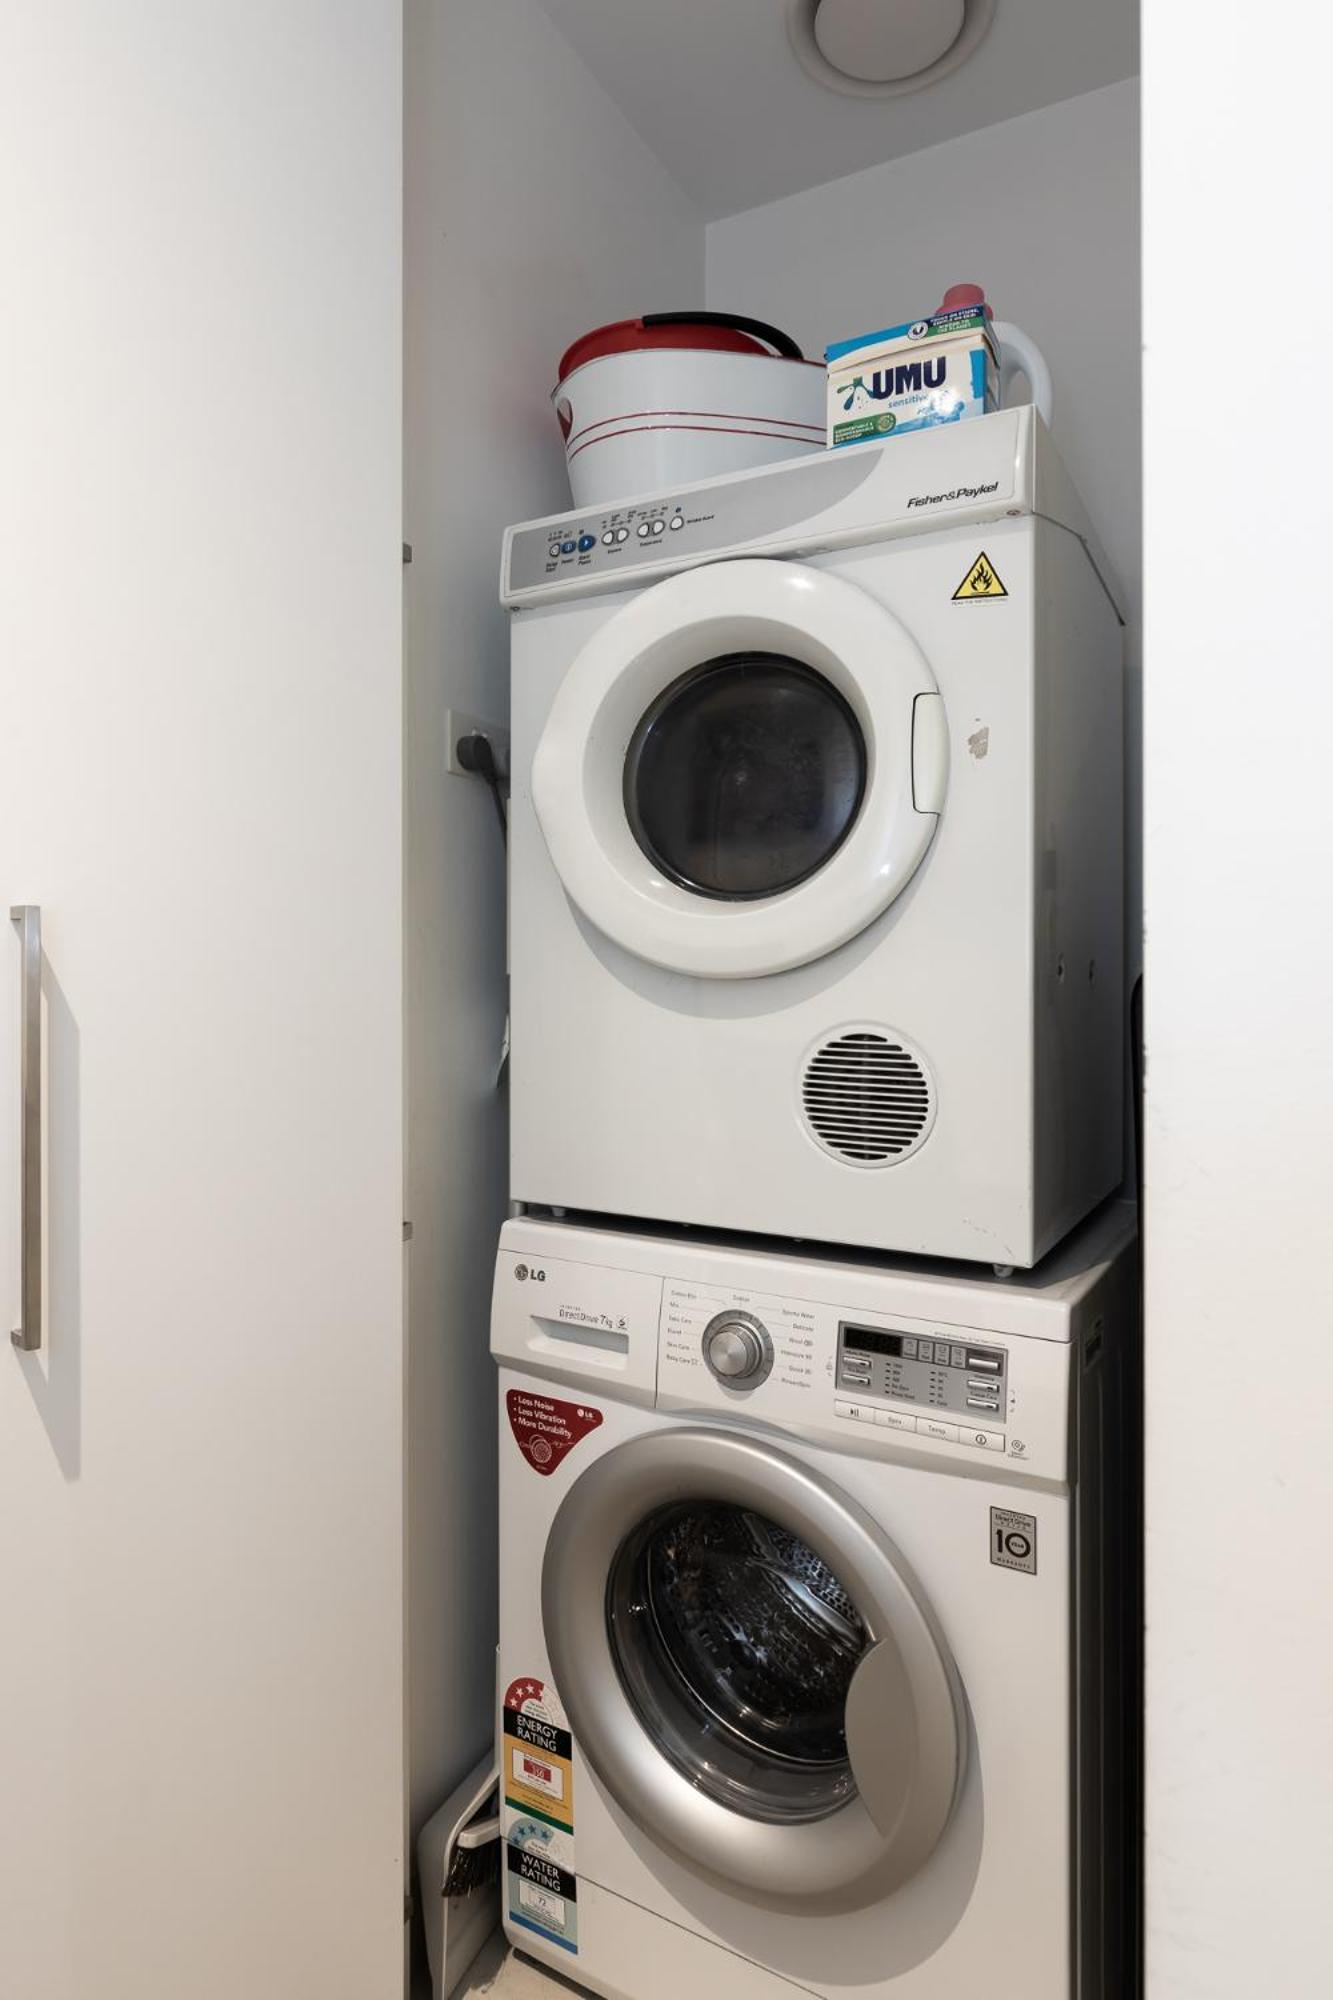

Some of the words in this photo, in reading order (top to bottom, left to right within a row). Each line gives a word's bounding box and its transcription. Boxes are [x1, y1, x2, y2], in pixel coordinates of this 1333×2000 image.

[872, 356, 946, 400] UMU
[907, 481, 999, 508] Fisher&Paykel
[530, 1269, 546, 1281] LG
[518, 1396, 533, 1407] Less
[534, 1400, 555, 1412] Noise
[518, 1406, 533, 1417] Less
[534, 1410, 567, 1425] Vibration
[518, 1417, 537, 1428] More
[538, 1421, 572, 1439] Durability
[996, 1529, 1031, 1558] 10
[516, 1715, 558, 1740] ENERGY
[517, 1726, 558, 1752] RATING
[520, 1865, 561, 1892] RATING
[522, 1853, 560, 1879] WATER
